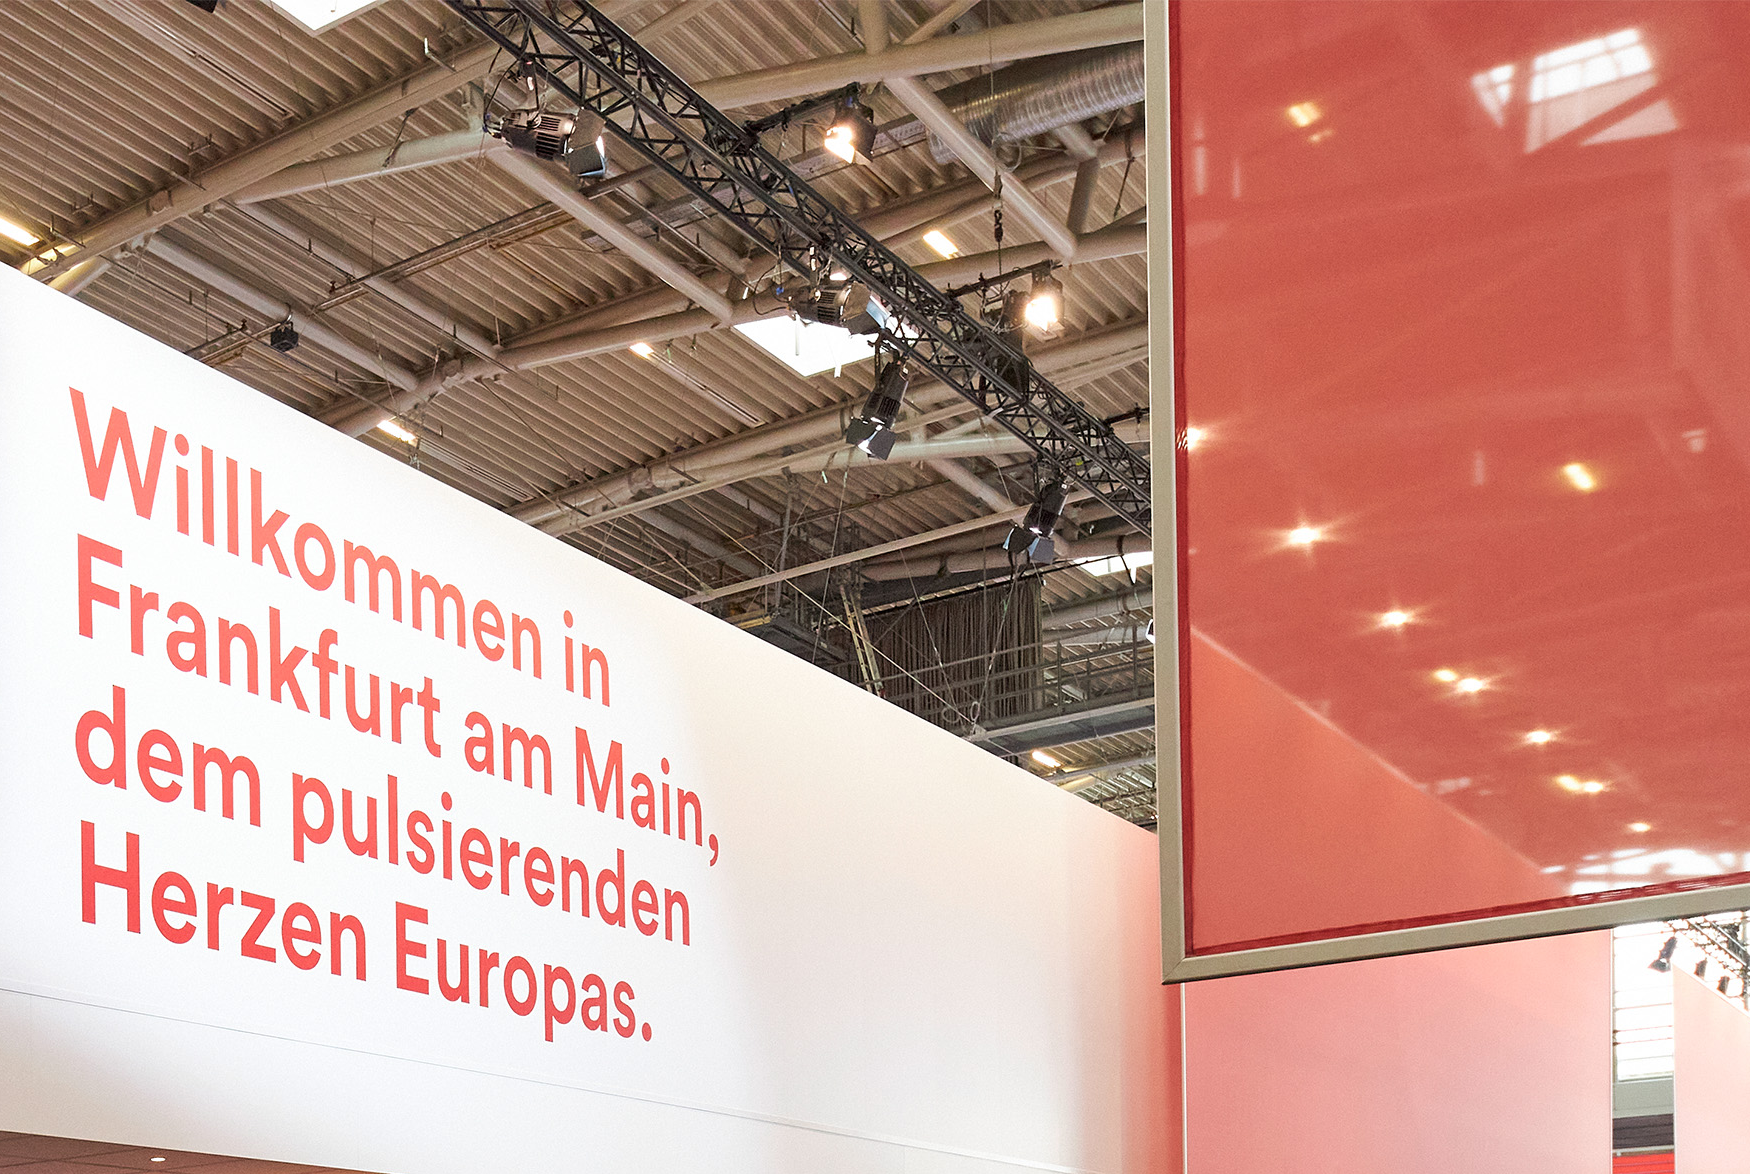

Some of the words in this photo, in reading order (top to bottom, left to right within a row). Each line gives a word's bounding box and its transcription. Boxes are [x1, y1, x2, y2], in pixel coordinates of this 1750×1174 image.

[68, 386, 542, 679] Willkommen
[563, 610, 610, 706] in
[75, 684, 261, 827] dem
[292, 772, 690, 946] pulsierenden
[77, 533, 441, 757] Frankfurt
[464, 711, 552, 795] am
[575, 727, 719, 866] Main,
[81, 819, 366, 980] Herzen
[396, 901, 652, 1042] Europas.
